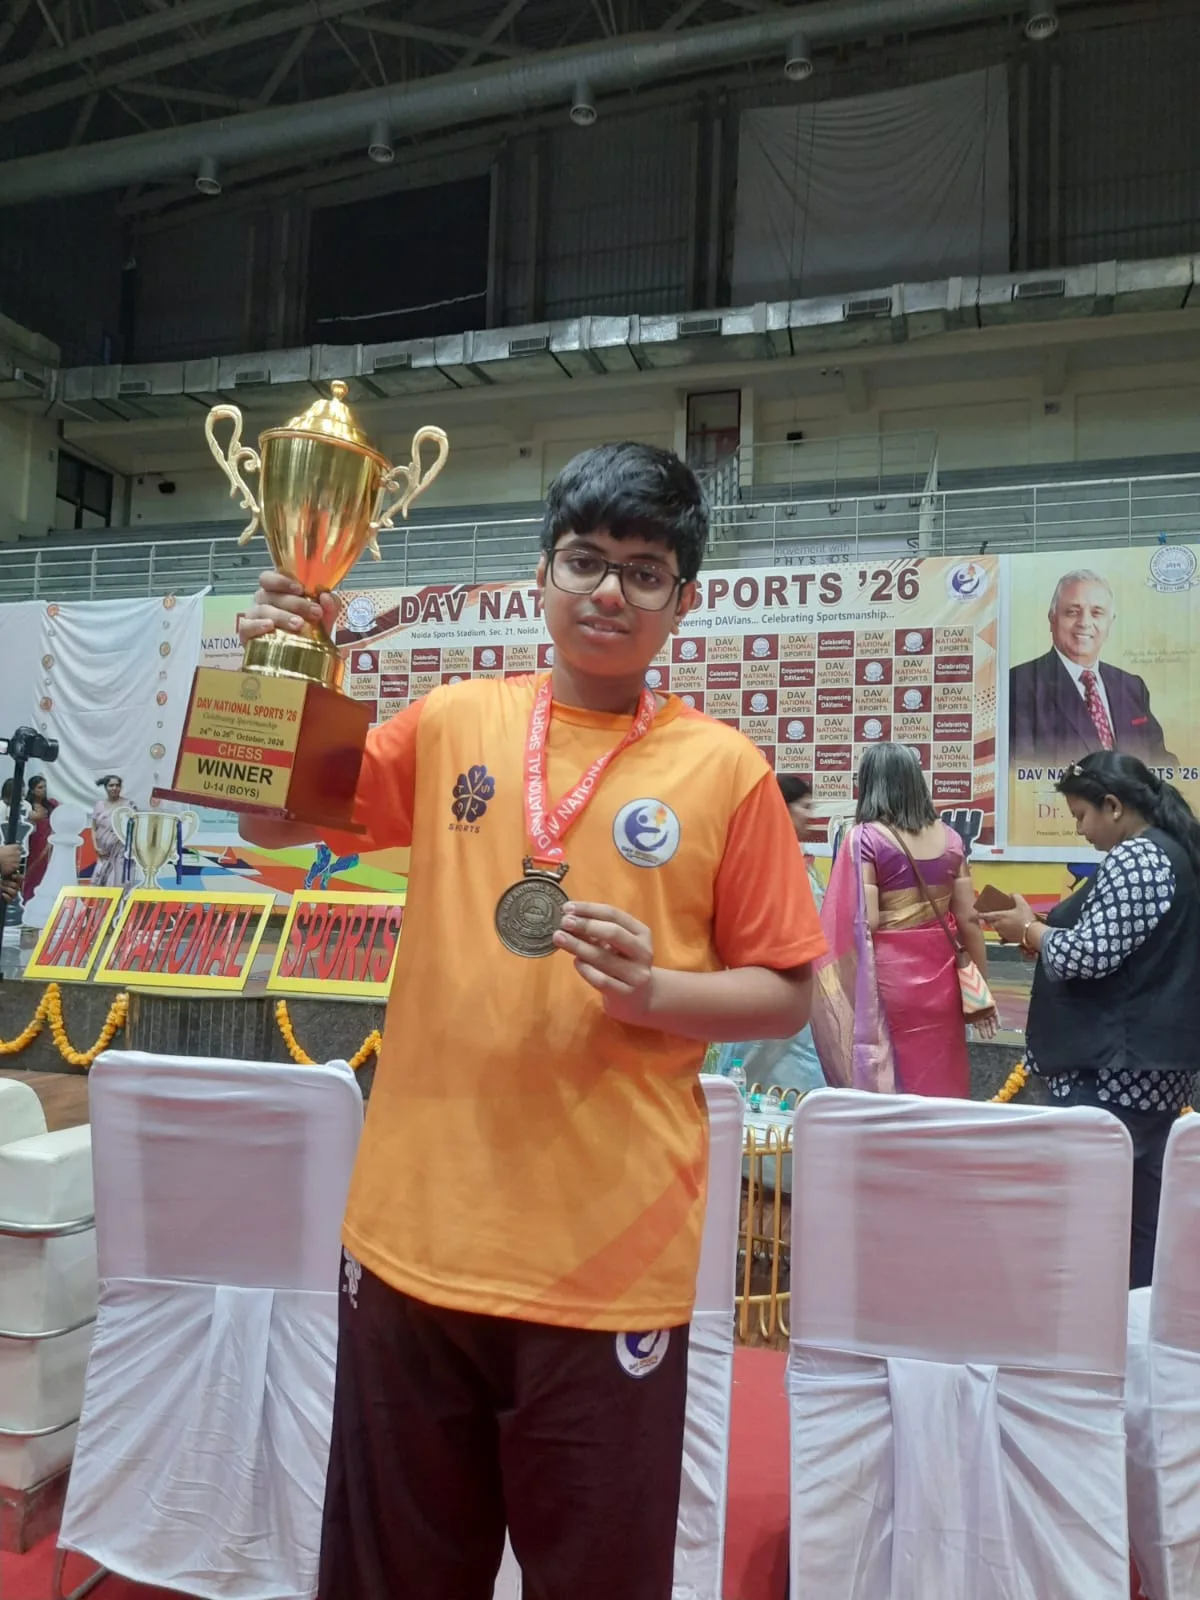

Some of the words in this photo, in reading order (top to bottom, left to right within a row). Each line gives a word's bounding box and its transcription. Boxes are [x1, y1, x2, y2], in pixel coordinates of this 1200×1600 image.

[401, 593, 466, 623] DAV
[480, 590, 543, 621] NAT
[859, 568, 920, 601] '26
[762, 612, 813, 626] Celebrating
[433, 631, 454, 639] Sports
[943, 629, 964, 637] DAV
[201, 637, 243, 649] NATIONA
[751, 664, 769, 672] DAV
[825, 662, 844, 670] DAV
[787, 691, 806, 699] DAV
[197, 698, 212, 709] DAV
[214, 699, 251, 716] NATIONAL
[254, 705, 285, 719] SPORTS
[287, 709, 297, 721] '26
[529, 700, 547, 750] SPORTS
[218, 743, 263, 760] CHESS
[198, 758, 273, 785] WINNER
[1018, 769, 1042, 780] DAV
[1048, 769, 1065, 780] NA
[1179, 767, 1199, 779] '26
[204, 781, 223, 792] U-14
[226, 783, 259, 798] (BOYS)
[1038, 804, 1063, 818] Dr.
[35, 897, 111, 966] DAV
[106, 901, 254, 978] NATIONAL
[280, 904, 402, 983] SPORTS
